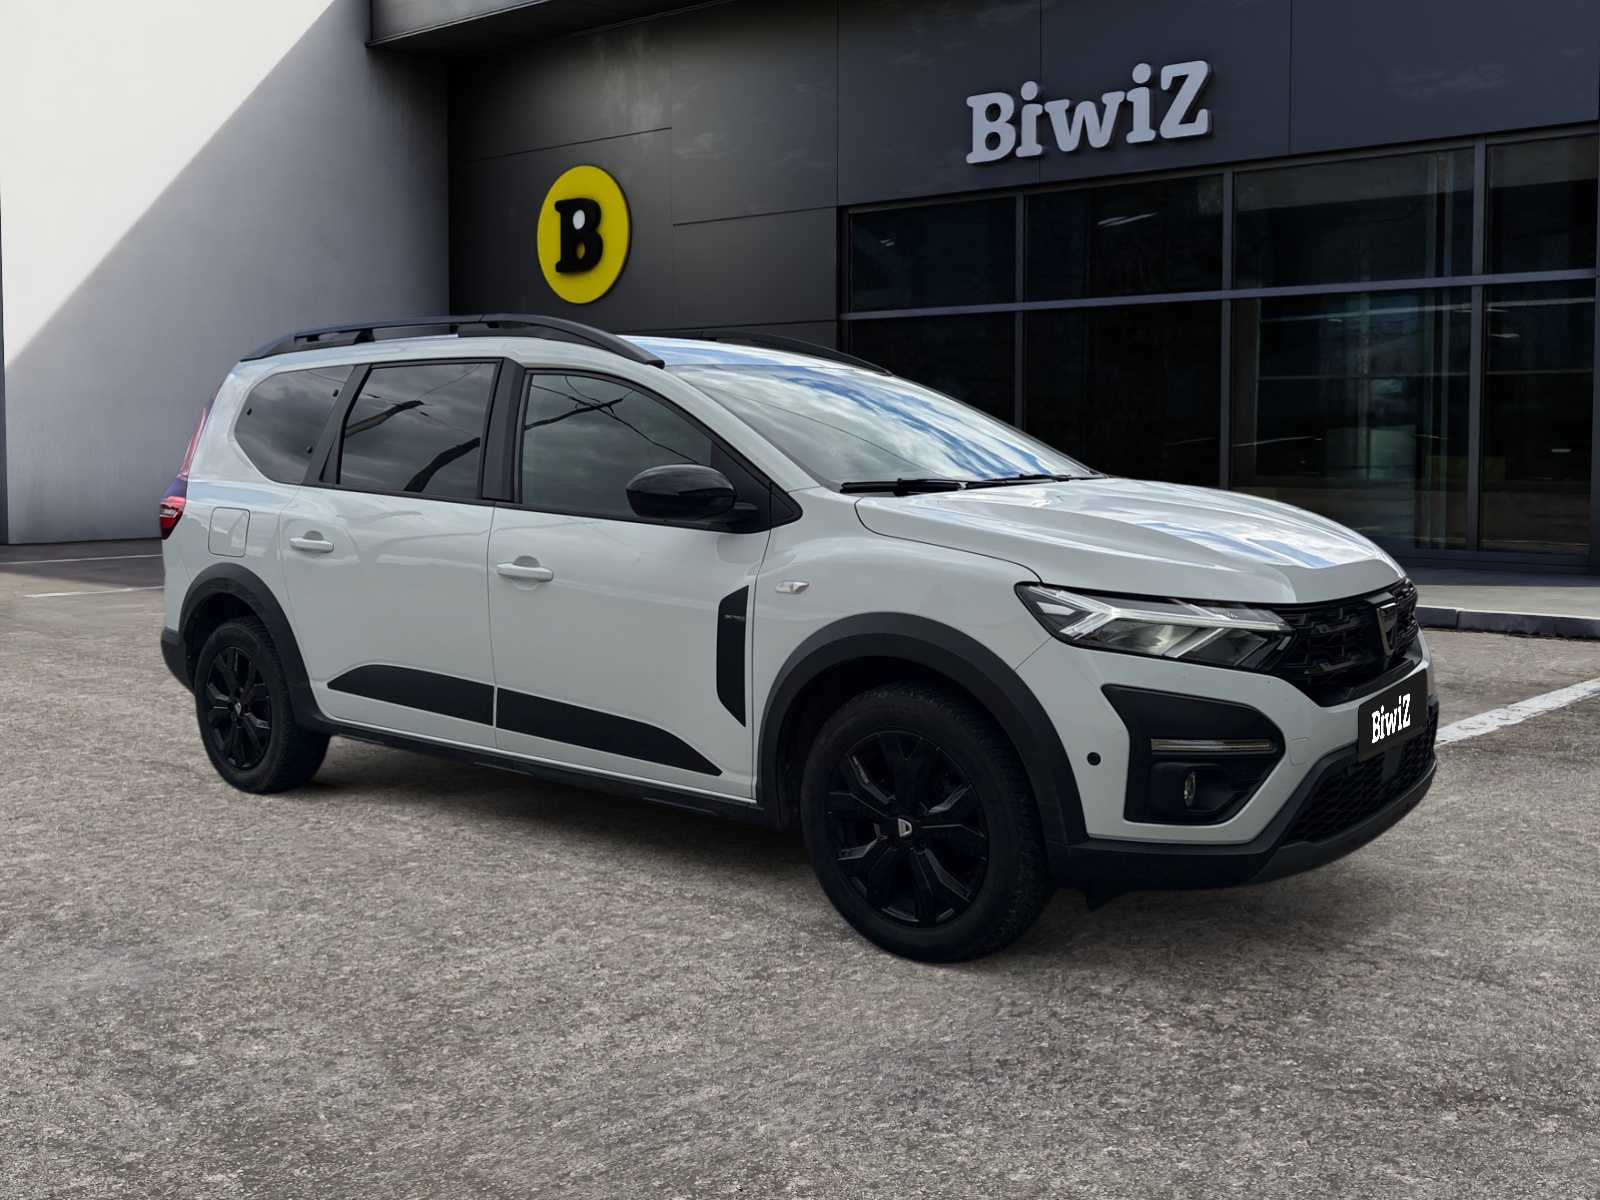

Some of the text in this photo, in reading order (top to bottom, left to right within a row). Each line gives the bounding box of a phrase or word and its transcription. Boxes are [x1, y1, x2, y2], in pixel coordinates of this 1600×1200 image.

[966, 60, 1210, 164] BiwiZ
[554, 198, 603, 273] B
[1371, 693, 1411, 744] BiwiZ
